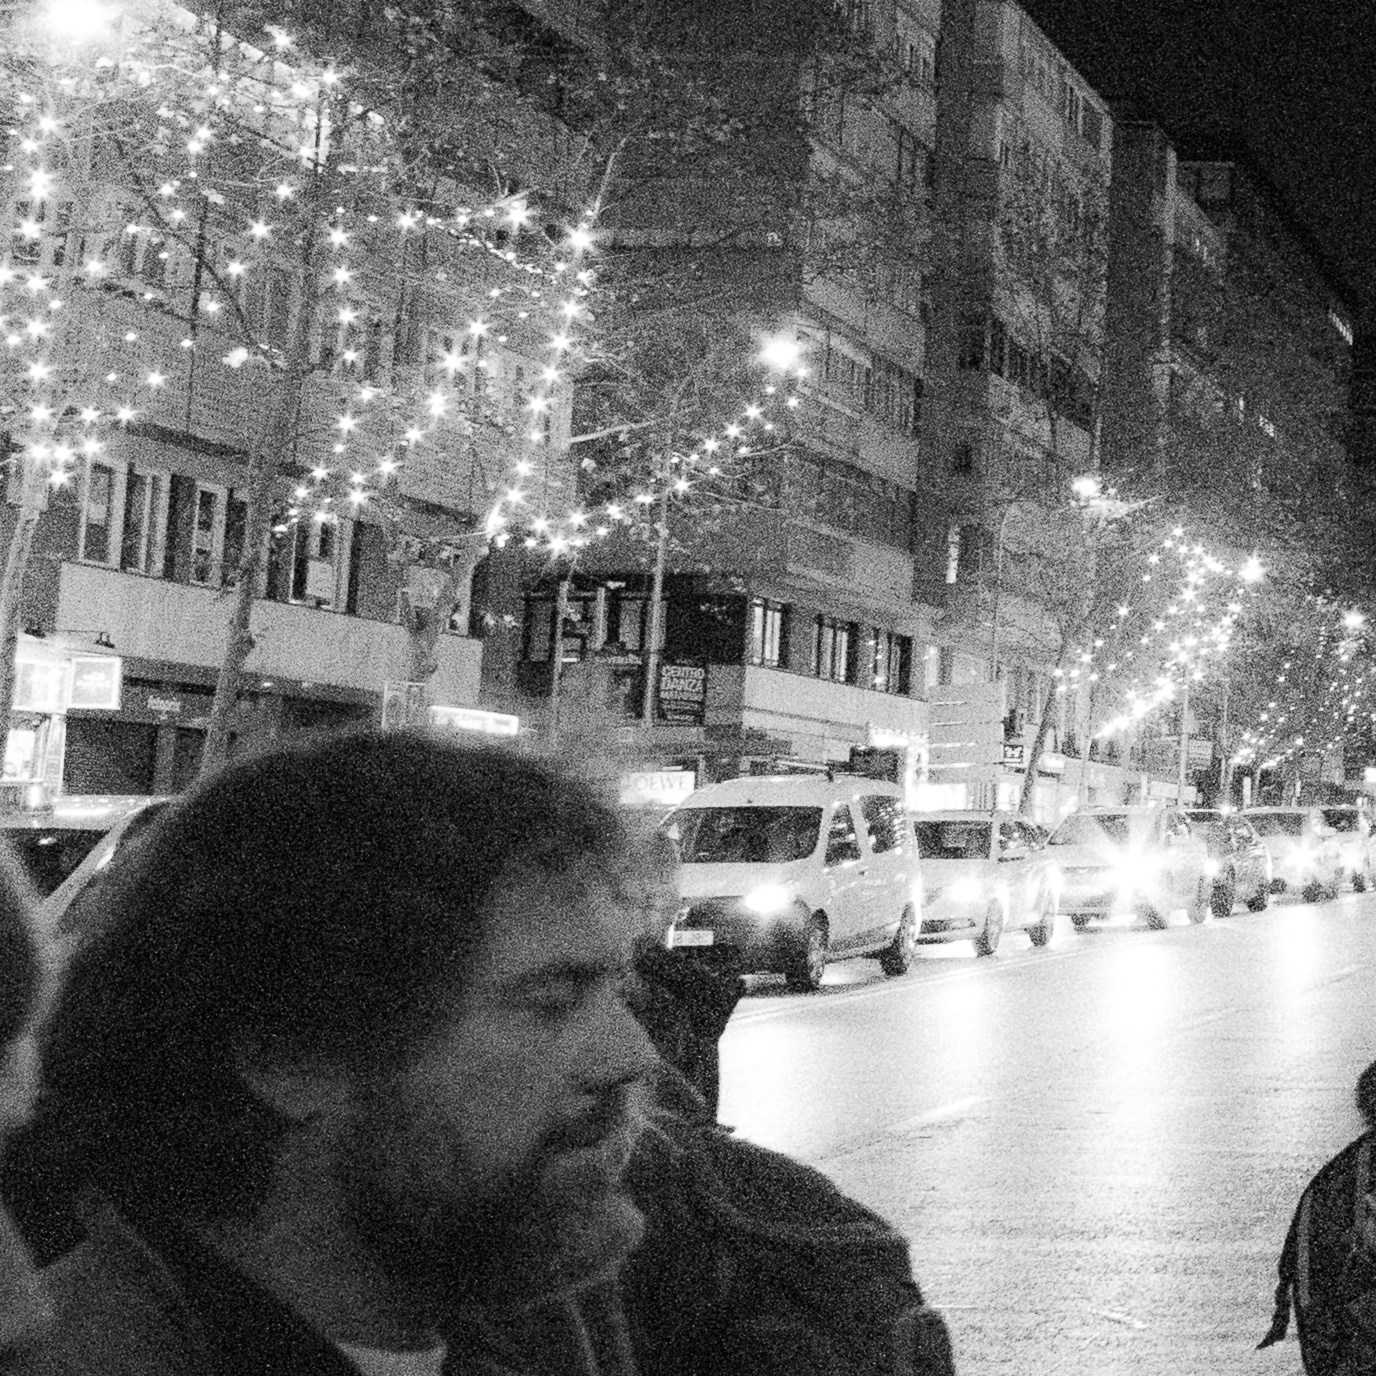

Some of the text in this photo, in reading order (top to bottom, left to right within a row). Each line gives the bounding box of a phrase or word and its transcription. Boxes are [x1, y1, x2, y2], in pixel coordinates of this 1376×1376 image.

[660, 664, 705, 679] CENTRO
[660, 677, 704, 692] DANZA
[627, 774, 688, 790] OEWE
